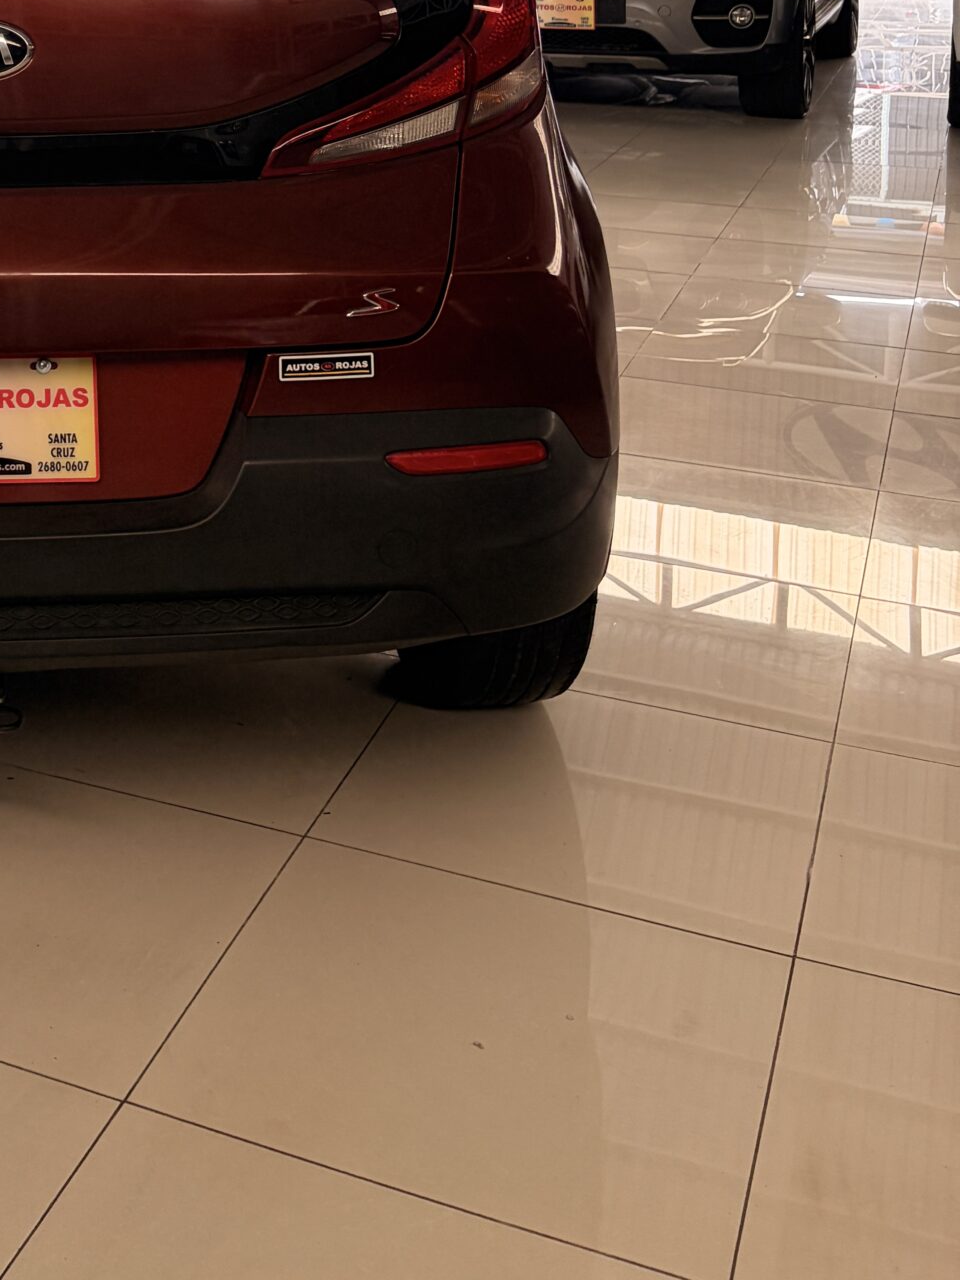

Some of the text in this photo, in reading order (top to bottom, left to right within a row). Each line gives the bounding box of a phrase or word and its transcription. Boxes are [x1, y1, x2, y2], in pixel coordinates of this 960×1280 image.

[346, 287, 400, 317] S
[286, 363, 320, 372] AUTOS
[335, 360, 368, 370] ROJAS
[48, 433, 78, 444] SANTA
[50, 447, 76, 458] CRUZ
[37, 460, 90, 472] 2680-0607
